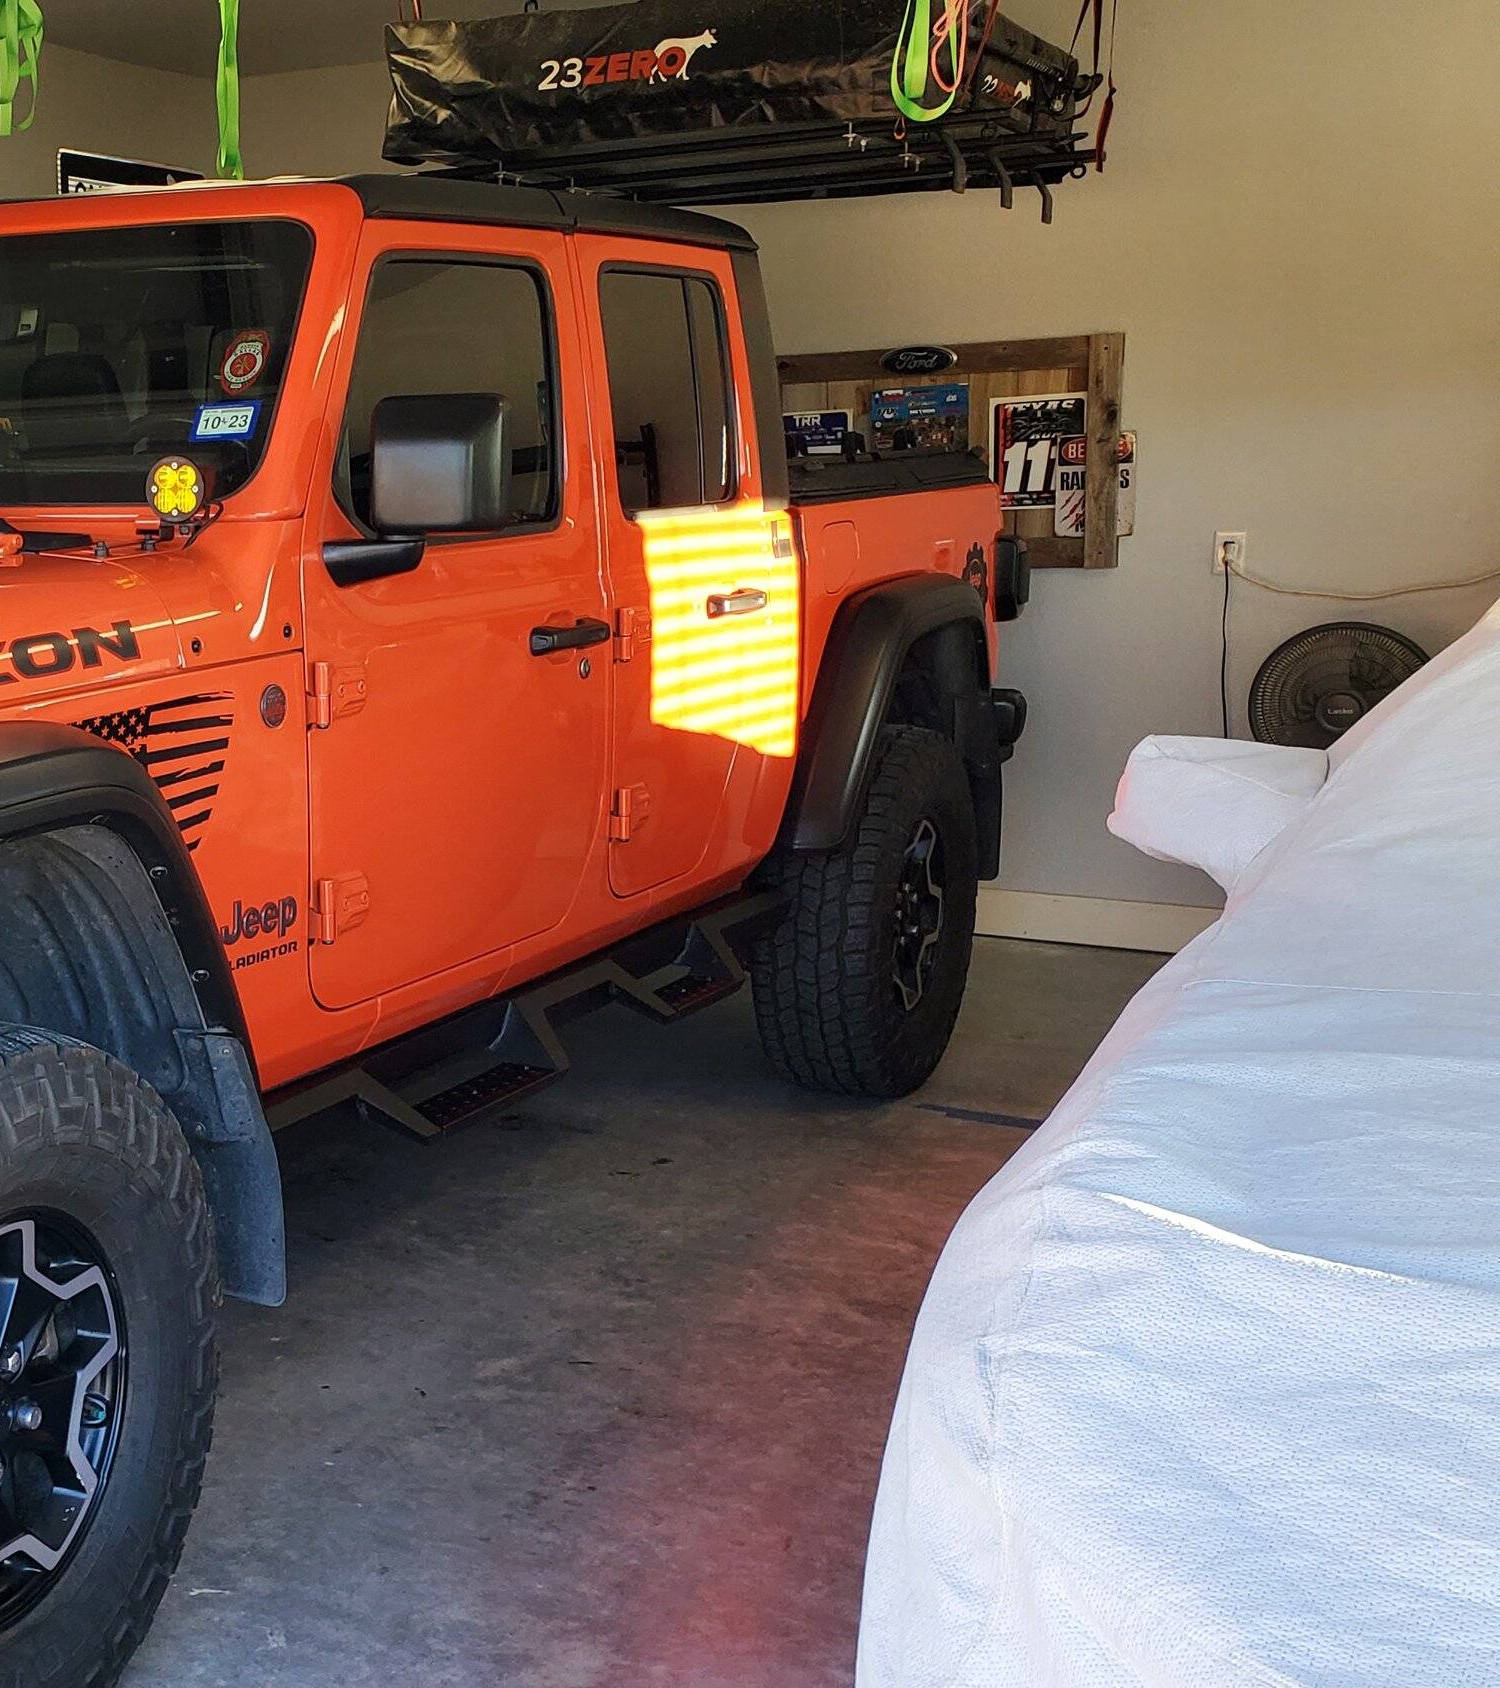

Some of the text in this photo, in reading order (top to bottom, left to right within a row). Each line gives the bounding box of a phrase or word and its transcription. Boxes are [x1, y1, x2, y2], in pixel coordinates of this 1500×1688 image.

[538, 46, 687, 91] 23ZERO
[895, 351, 938, 369] Ford
[203, 414, 249, 430] 10 23
[793, 414, 821, 427] TRR
[220, 896, 297, 945] Jeep
[229, 941, 298, 970] LADIATOR
